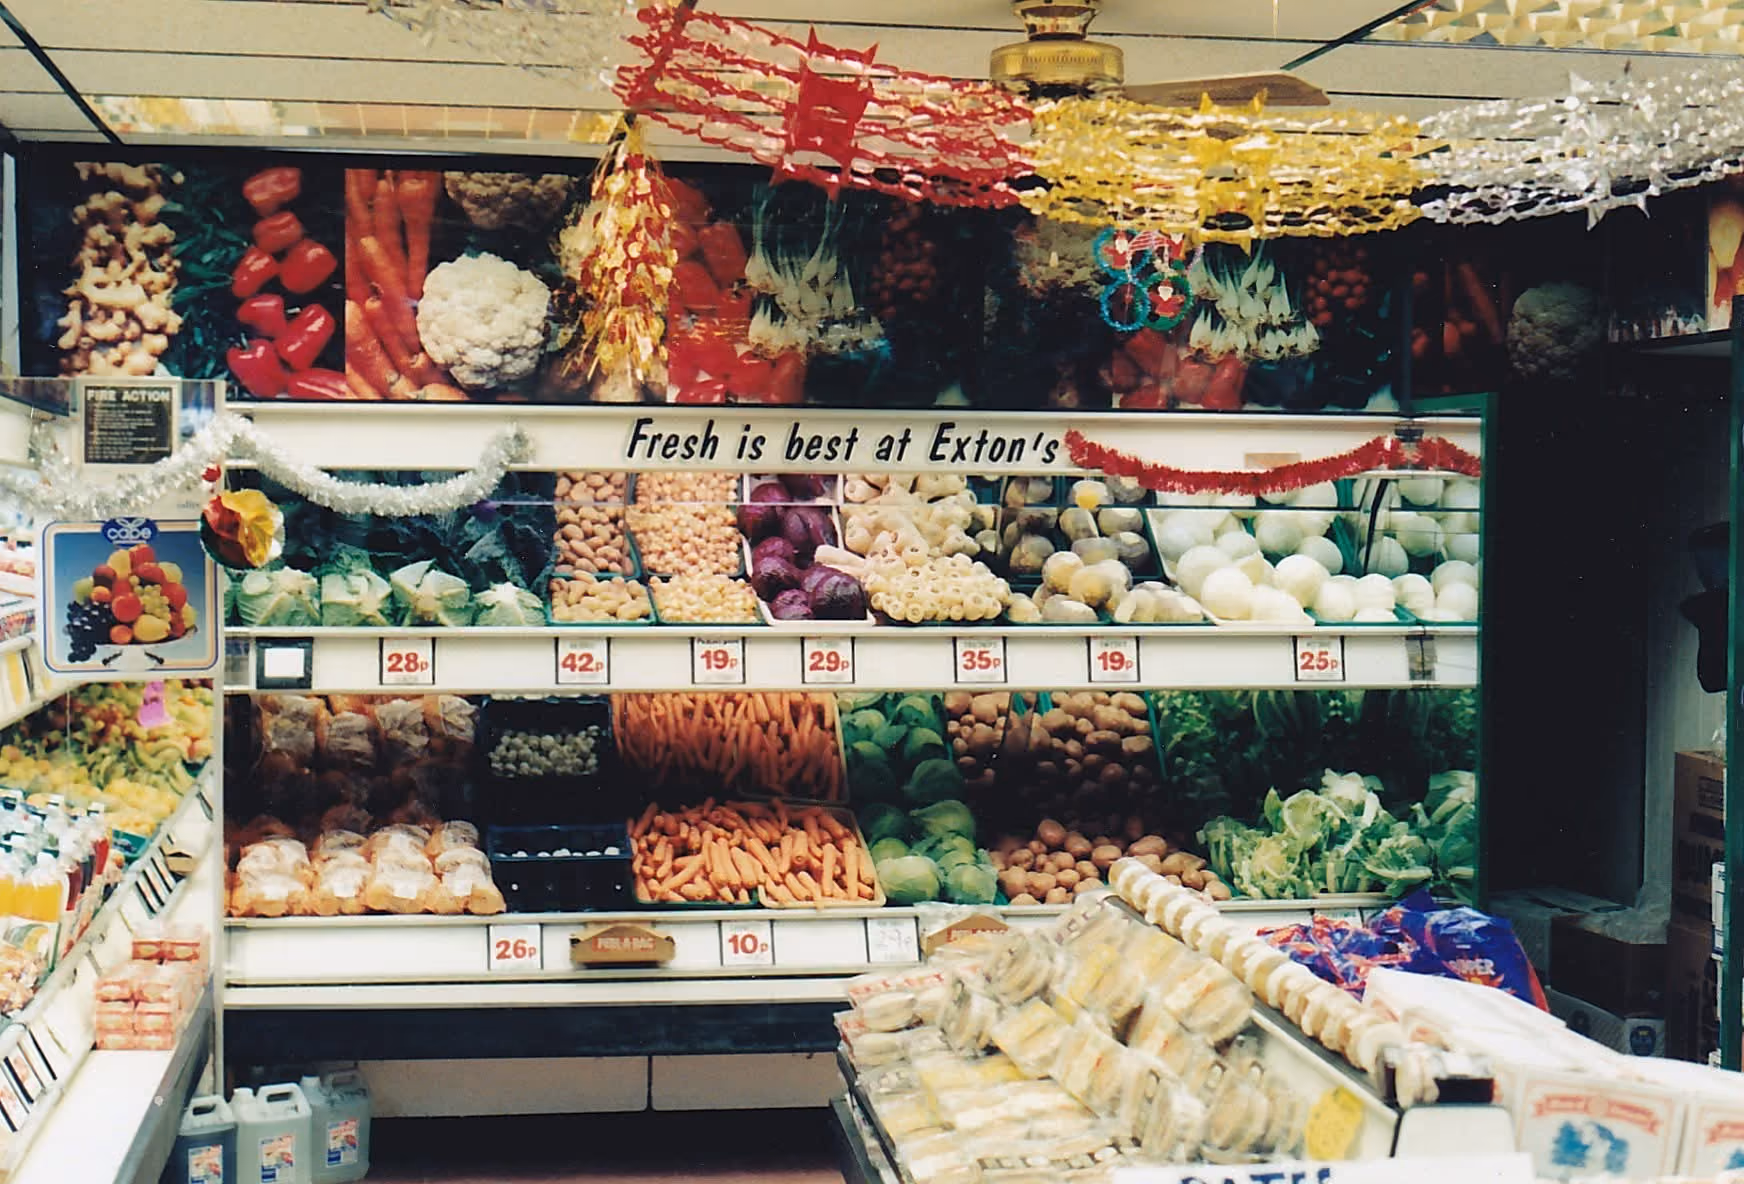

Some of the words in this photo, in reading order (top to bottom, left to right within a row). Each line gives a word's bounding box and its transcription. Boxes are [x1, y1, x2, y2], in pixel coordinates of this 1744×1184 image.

[86, 389, 117, 402] FIRE
[122, 389, 171, 403] ACTION
[627, 417, 718, 460] Fresh
[736, 422, 765, 460] is
[784, 421, 858, 460] best
[874, 427, 911, 462] at
[928, 420, 1058, 463] Exton's
[387, 652, 430, 672] 28p
[561, 652, 604, 672] 42p
[700, 649, 738, 670] 19p
[809, 650, 849, 672] 29p
[962, 649, 1001, 670] 35p
[1097, 651, 1134, 671] 19p
[1300, 650, 1338, 671] 25p
[495, 939, 537, 960] 26p
[728, 933, 769, 954] 10p
